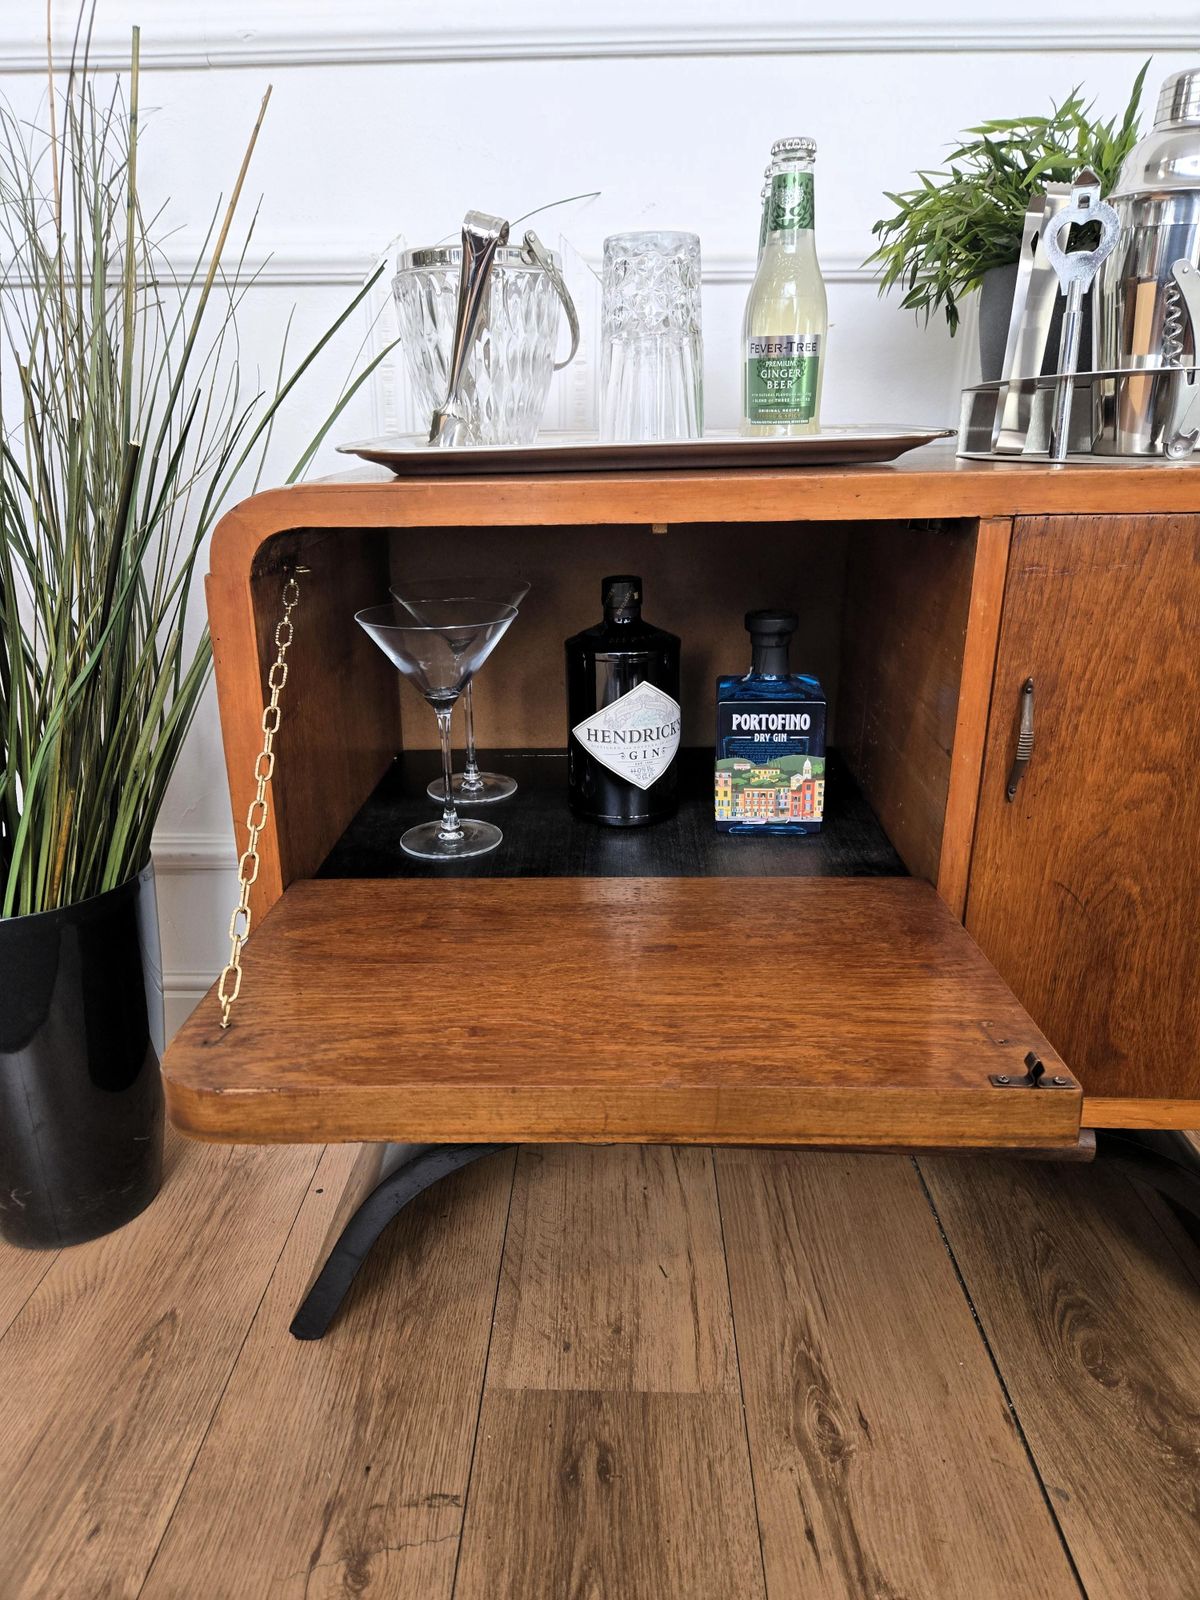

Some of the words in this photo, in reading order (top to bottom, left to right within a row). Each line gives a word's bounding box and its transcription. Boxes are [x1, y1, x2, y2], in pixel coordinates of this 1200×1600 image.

[750, 341, 817, 354] FEVER-TREE
[760, 368, 801, 378] GINGER
[767, 380, 793, 389] BEER
[731, 713, 811, 731] PORTOFINO
[753, 733, 771, 742] DRY
[772, 733, 788, 742] GIN
[628, 747, 661, 761] GIN
